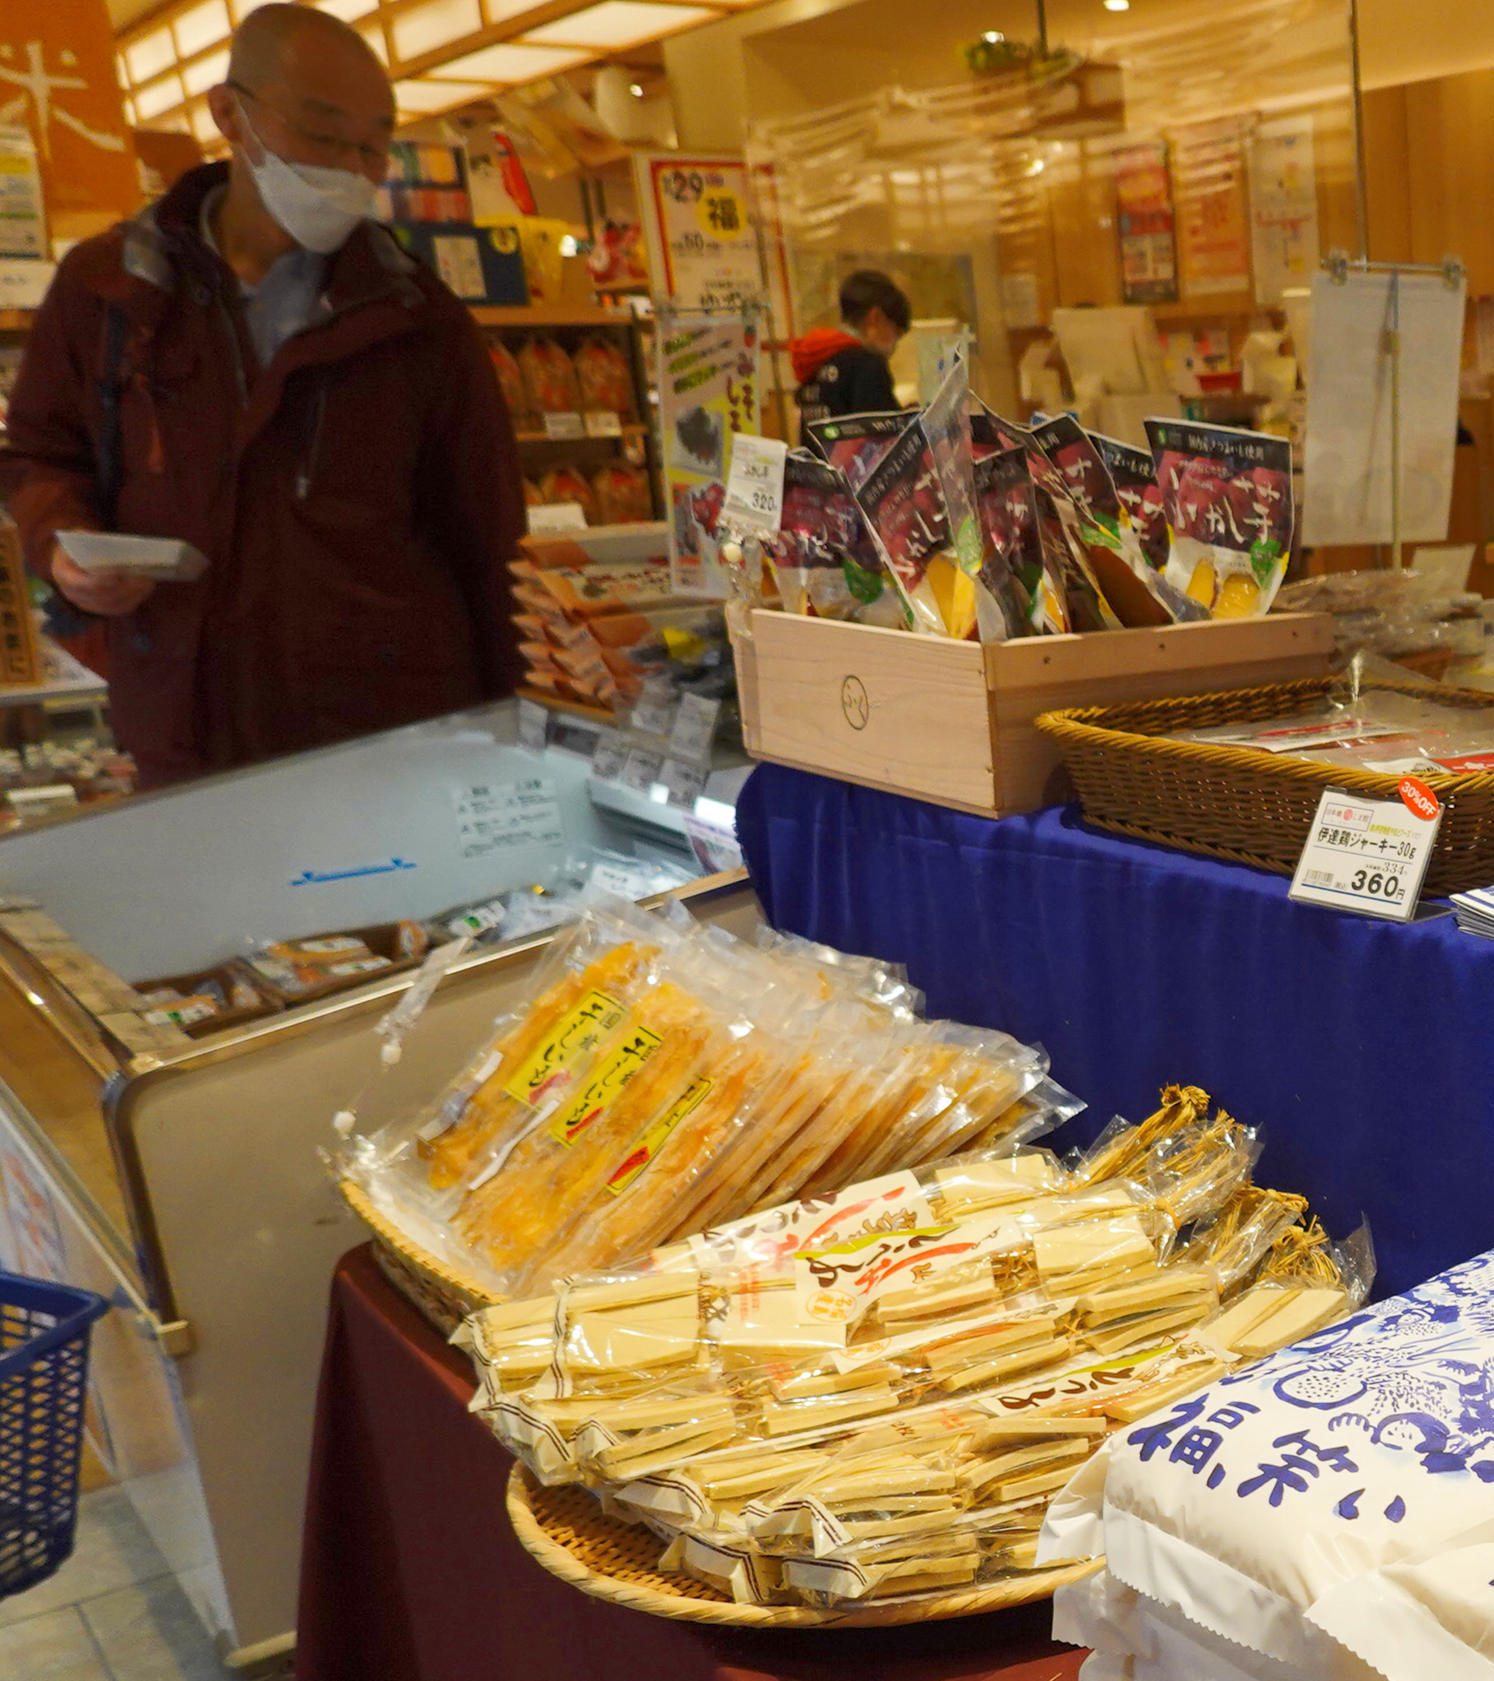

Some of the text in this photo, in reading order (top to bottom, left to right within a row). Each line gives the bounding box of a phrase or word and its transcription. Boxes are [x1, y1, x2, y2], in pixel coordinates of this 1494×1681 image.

[752, 492, 775, 512] 320
[1401, 781, 1437, 816] 30%OFF
[1351, 869, 1405, 900] 360円
[1127, 1392, 1407, 1524] 福、笑い
